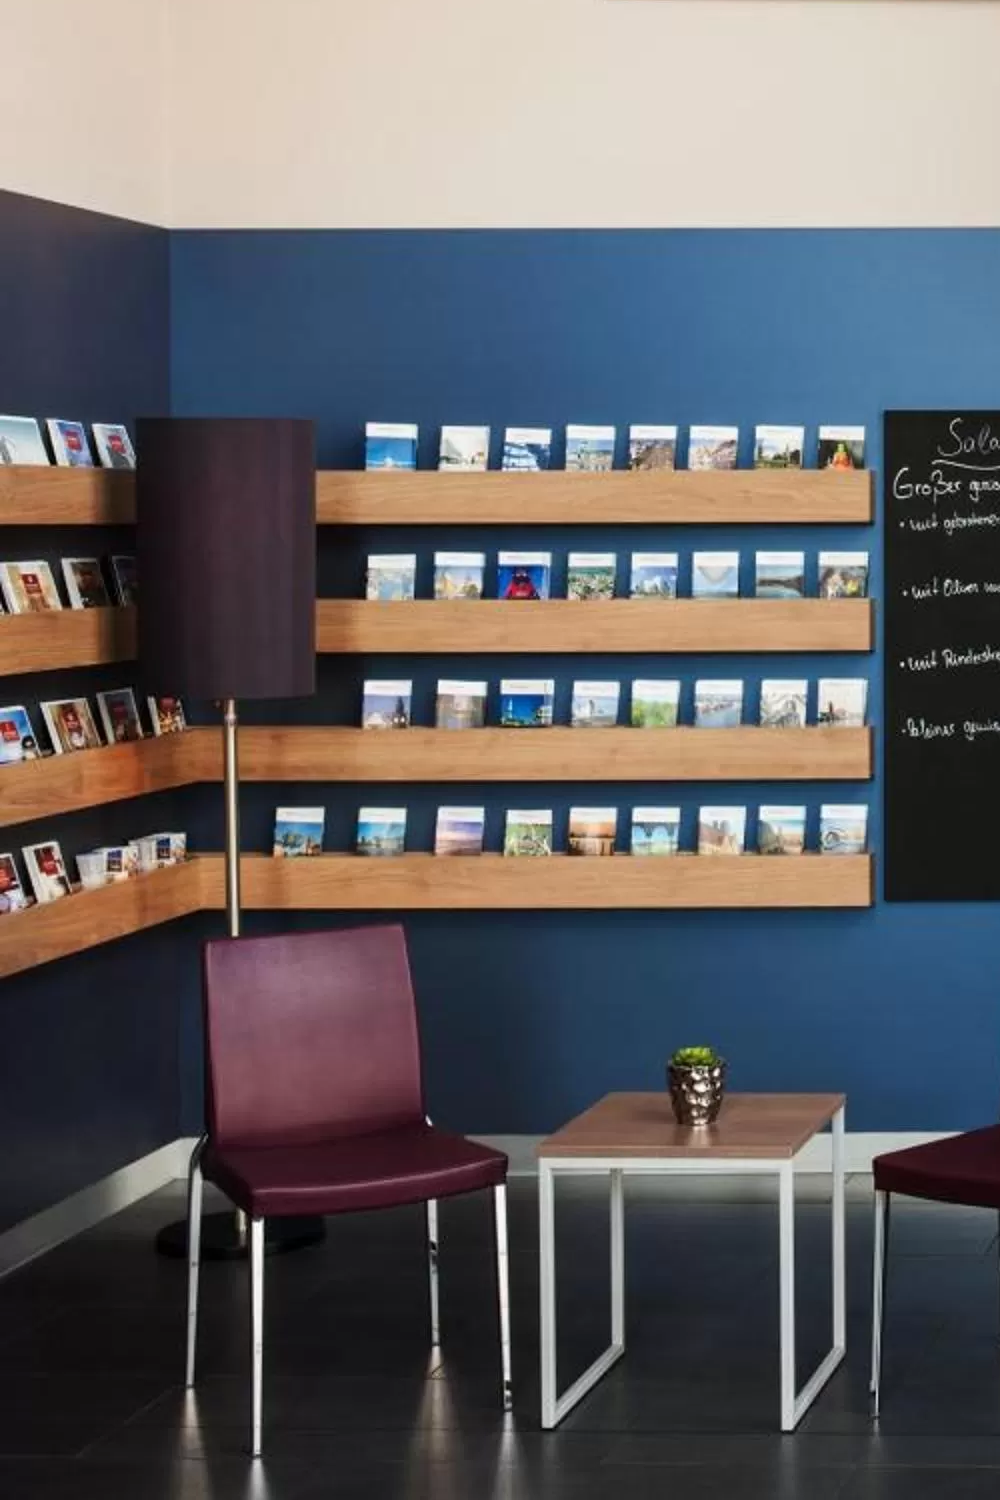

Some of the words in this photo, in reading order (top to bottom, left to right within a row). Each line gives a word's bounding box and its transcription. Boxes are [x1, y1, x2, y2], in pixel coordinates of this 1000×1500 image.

[892, 466, 963, 506] Großer
[909, 512, 939, 532] mit
[911, 575, 939, 599] mit
[907, 649, 938, 671] mit
